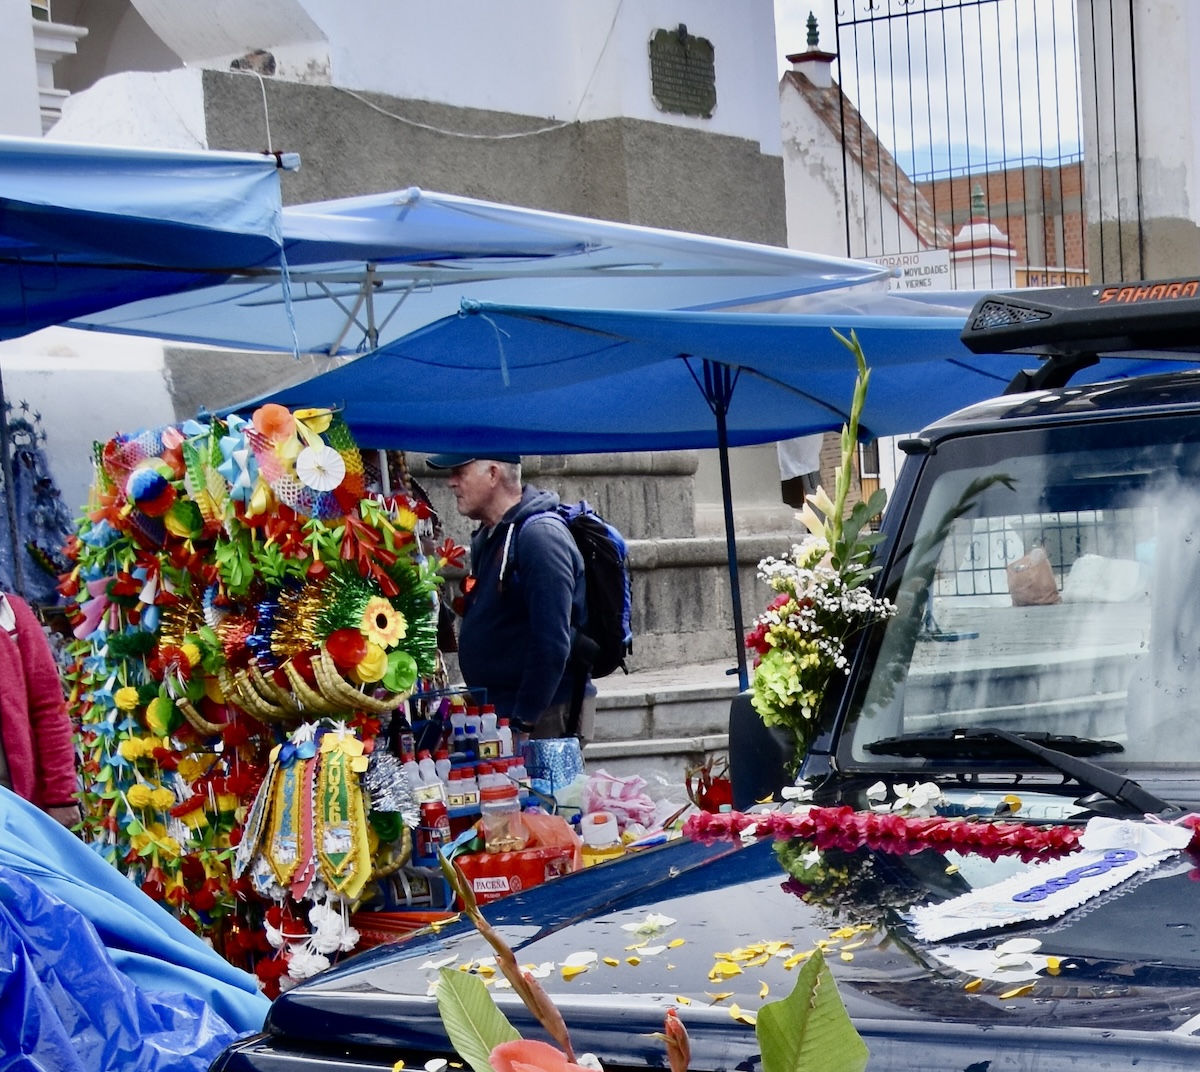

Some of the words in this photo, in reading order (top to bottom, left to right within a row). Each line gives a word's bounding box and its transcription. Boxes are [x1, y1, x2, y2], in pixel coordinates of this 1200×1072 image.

[904, 264, 949, 277] MOVILIDADES
[905, 278, 932, 289] VIERNES
[1099, 280, 1200, 304] SAHARA
[475, 879, 508, 890] PACEÑA
